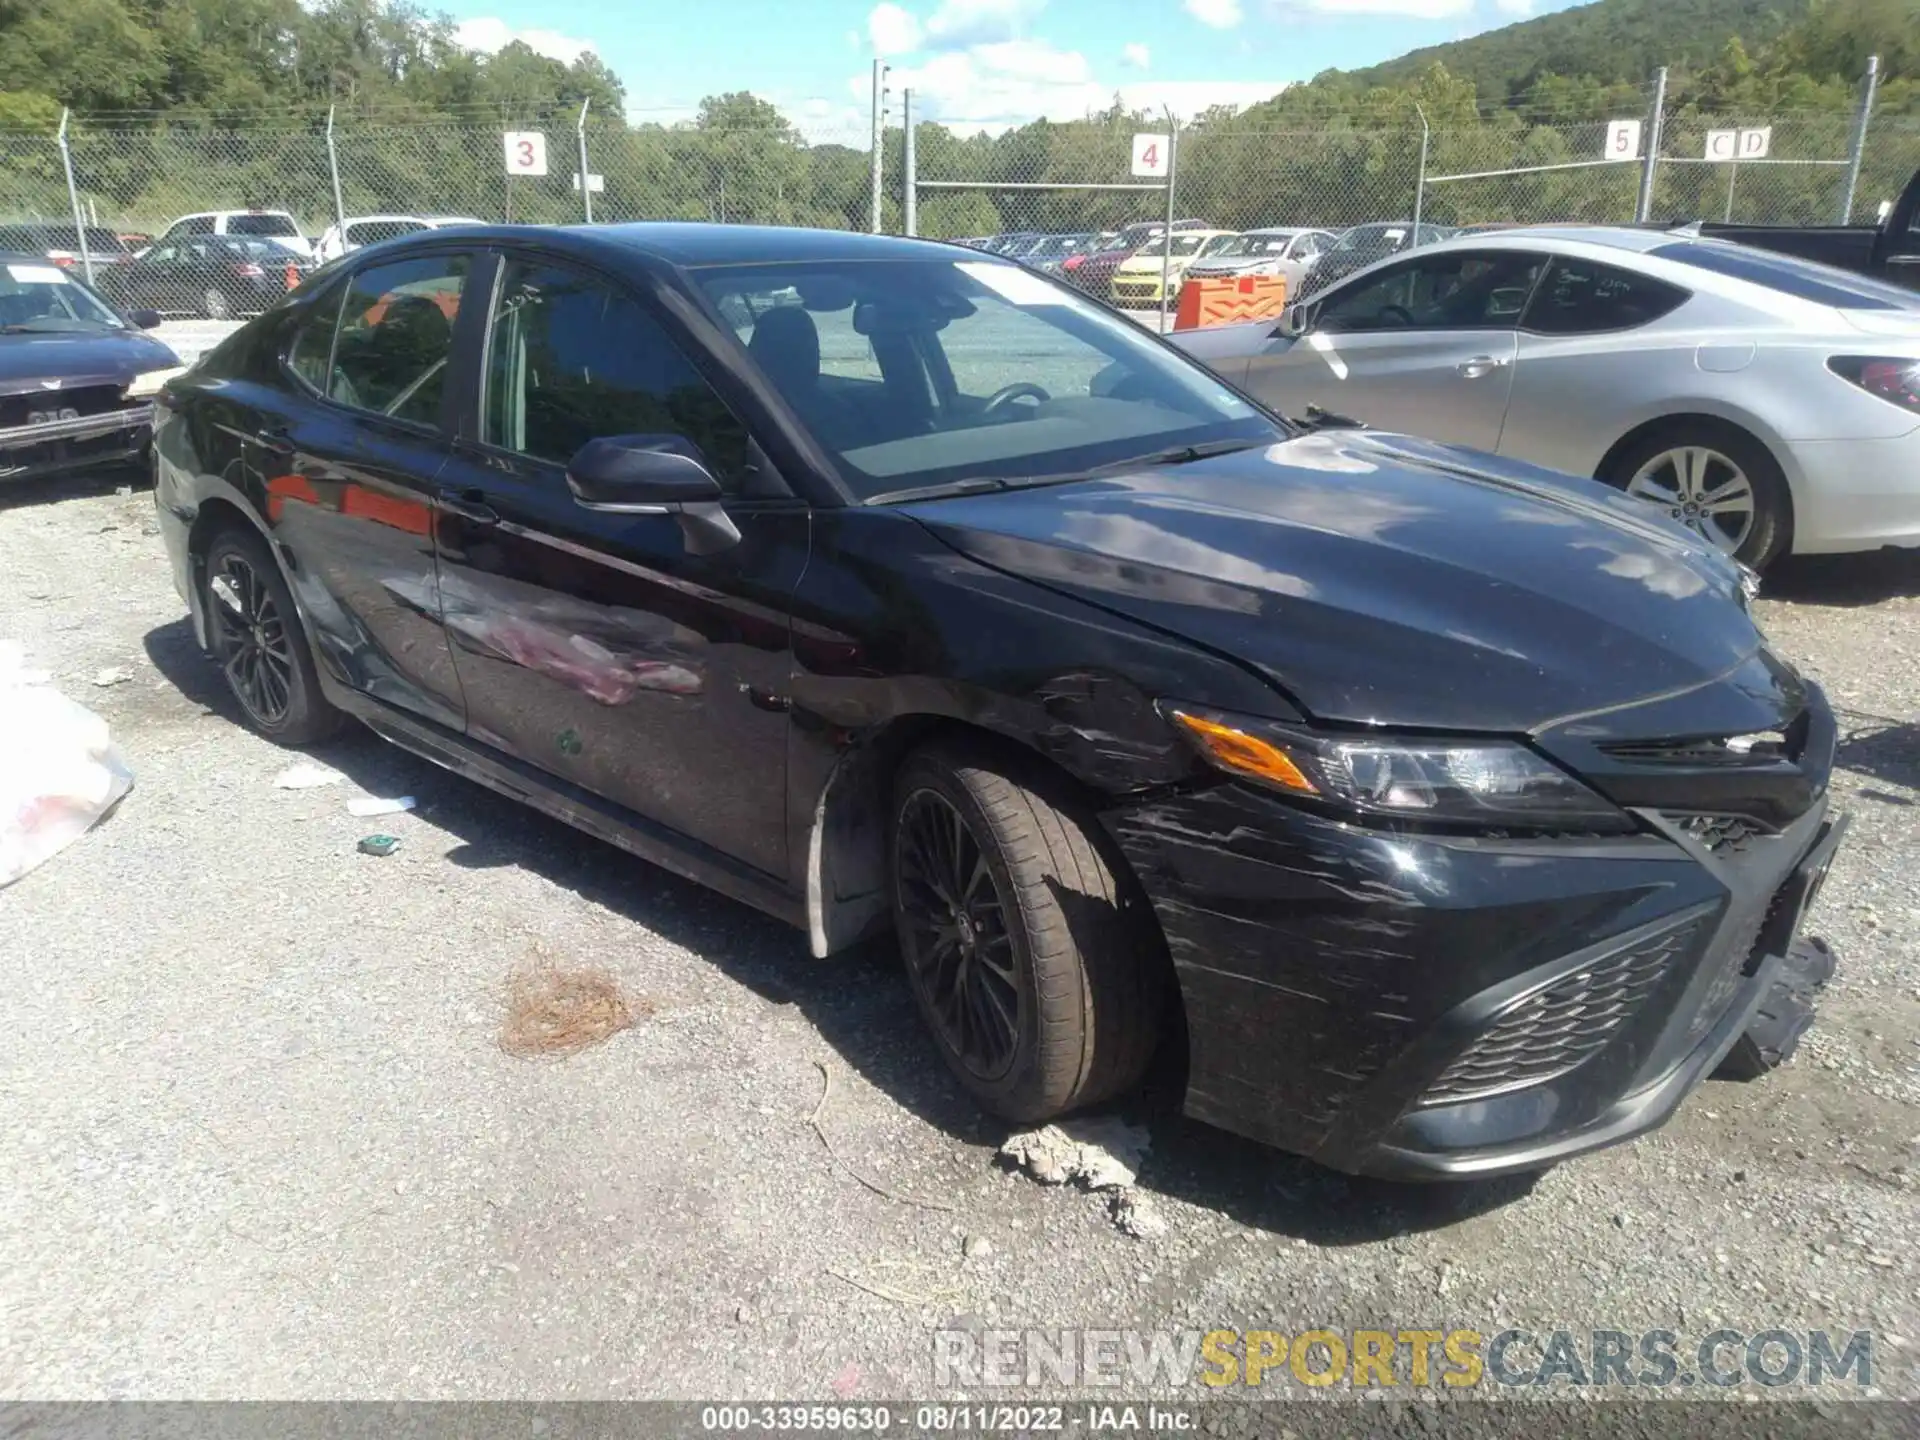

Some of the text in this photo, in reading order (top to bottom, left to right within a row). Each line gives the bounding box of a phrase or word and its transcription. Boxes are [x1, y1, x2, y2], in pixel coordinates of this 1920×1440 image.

[1615, 129, 1628, 152] 5
[1713, 135, 1729, 155] C
[1746, 133, 1763, 153] D
[517, 141, 534, 167] 3
[1142, 144, 1160, 168] 4
